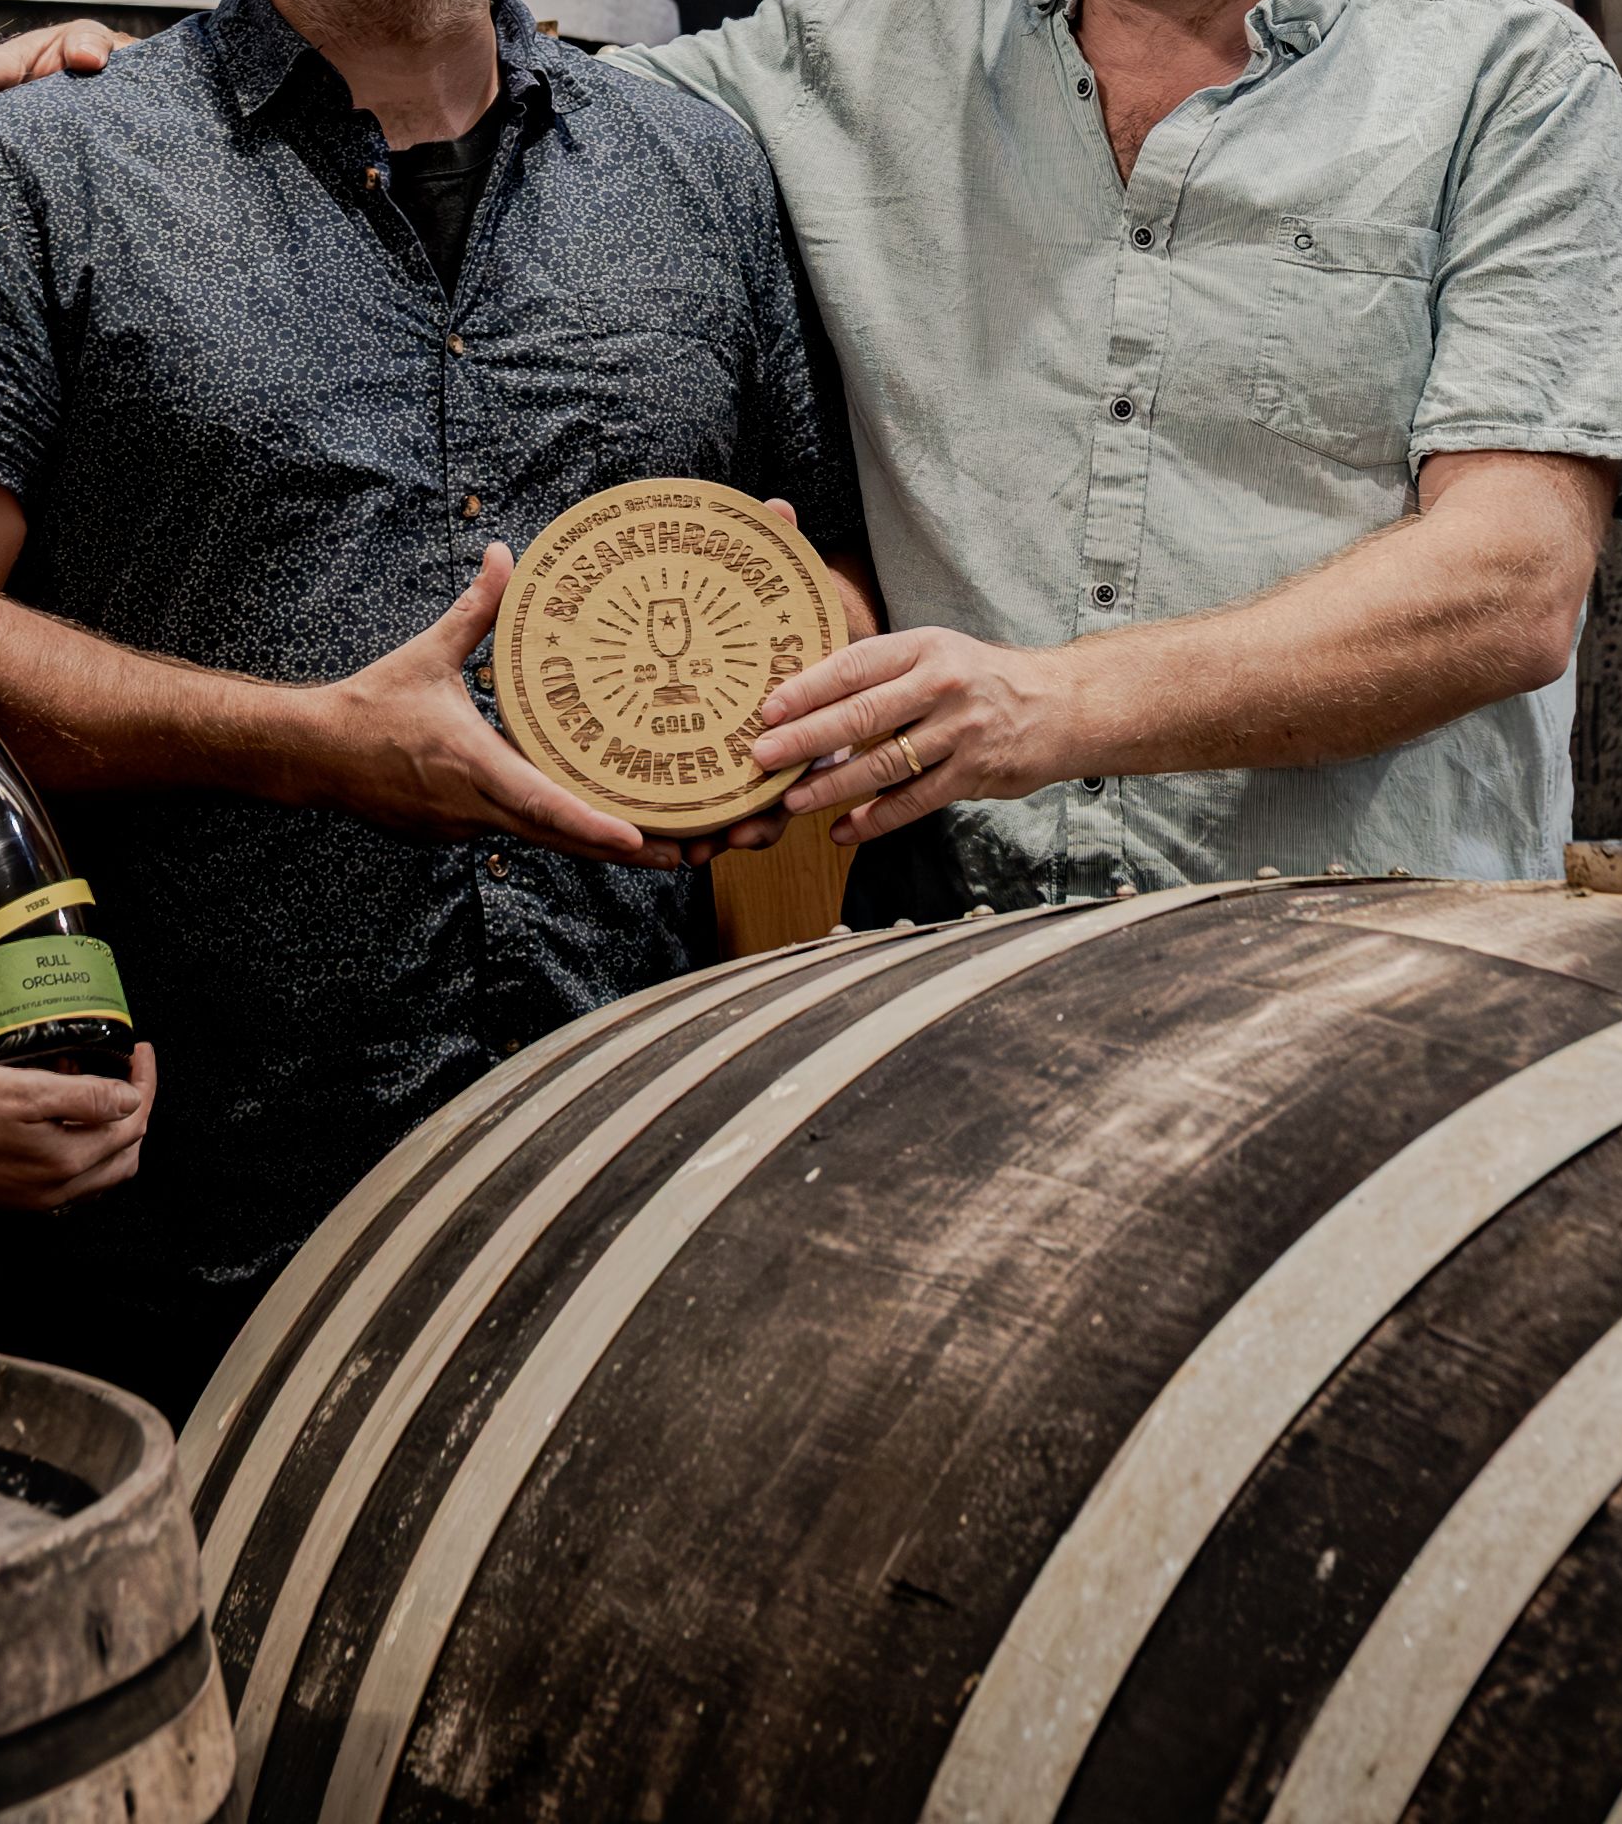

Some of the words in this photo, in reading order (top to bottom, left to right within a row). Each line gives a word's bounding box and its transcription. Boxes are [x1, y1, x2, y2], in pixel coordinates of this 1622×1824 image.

[532, 552, 558, 578] THE
[552, 504, 622, 556] SANDFORD
[624, 494, 702, 513] ORCHARDS
[543, 521, 791, 623] BREAKTHROUGH
[633, 663, 658, 683] 20
[689, 658, 714, 677] 25
[540, 656, 605, 752] CIDER
[600, 736, 725, 786] MAKER
[724, 634, 804, 767] AWDS
[650, 712, 706, 736] GOLD
[36, 954, 70, 968] RULL
[22, 972, 90, 990] ORCHARD
